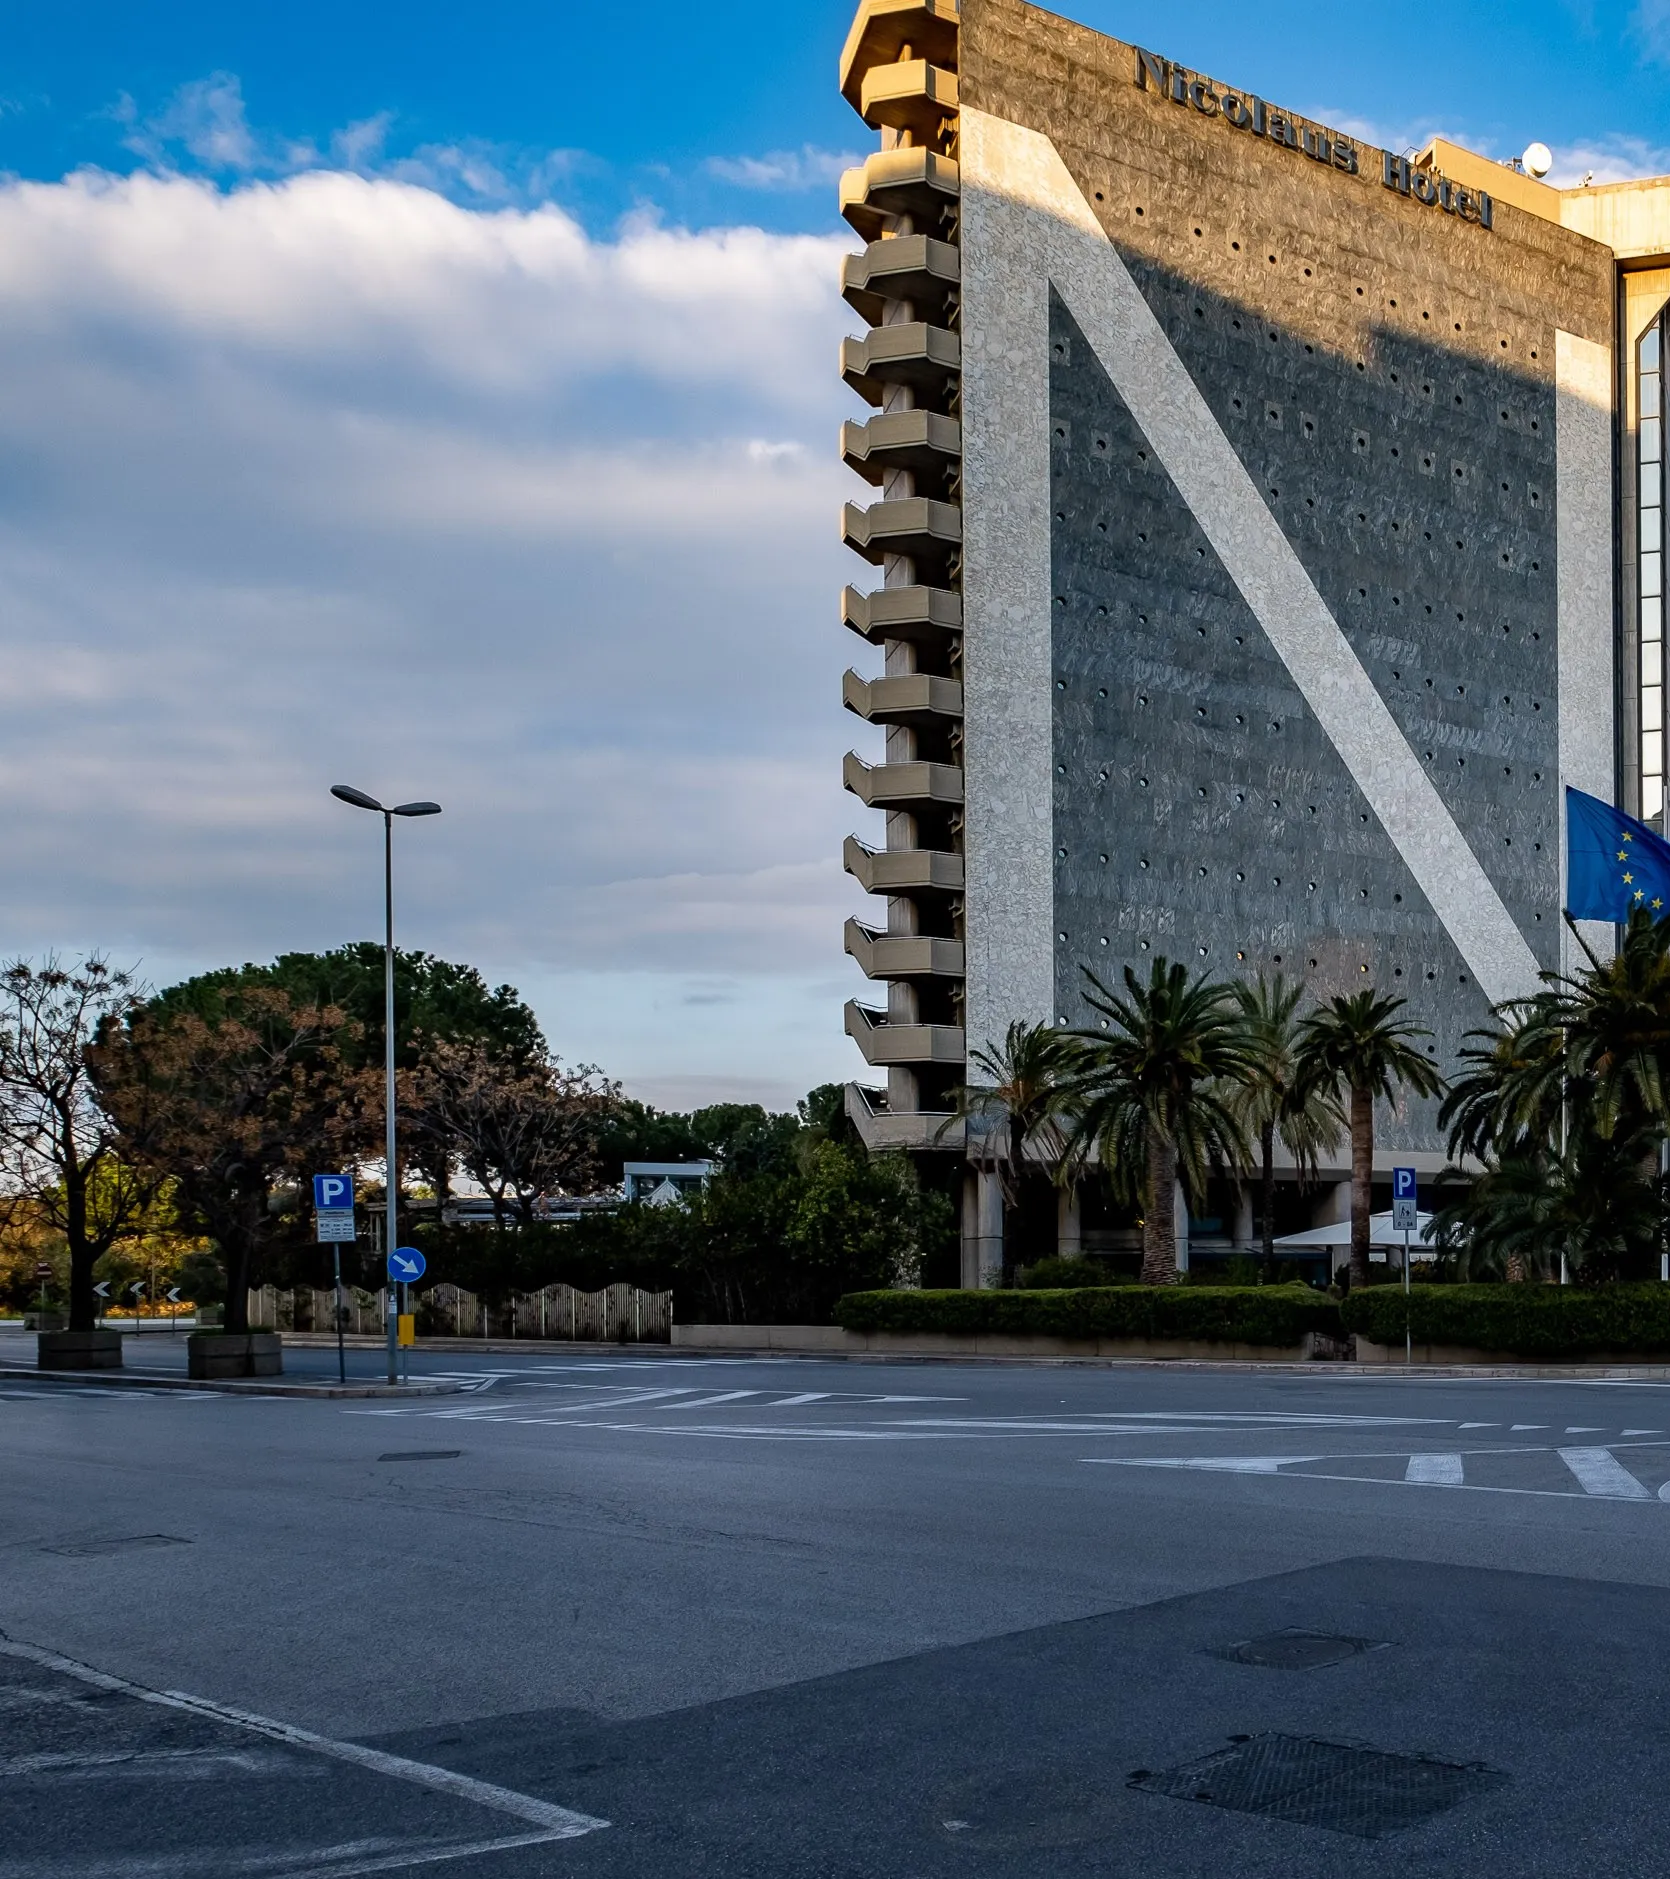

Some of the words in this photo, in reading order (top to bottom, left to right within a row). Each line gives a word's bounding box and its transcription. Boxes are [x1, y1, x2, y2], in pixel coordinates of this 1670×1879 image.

[1134, 45, 1358, 175] Nicolaus
[1382, 148, 1493, 230] Hotel
[322, 1179, 344, 1204] P
[1398, 1171, 1412, 1195] P
